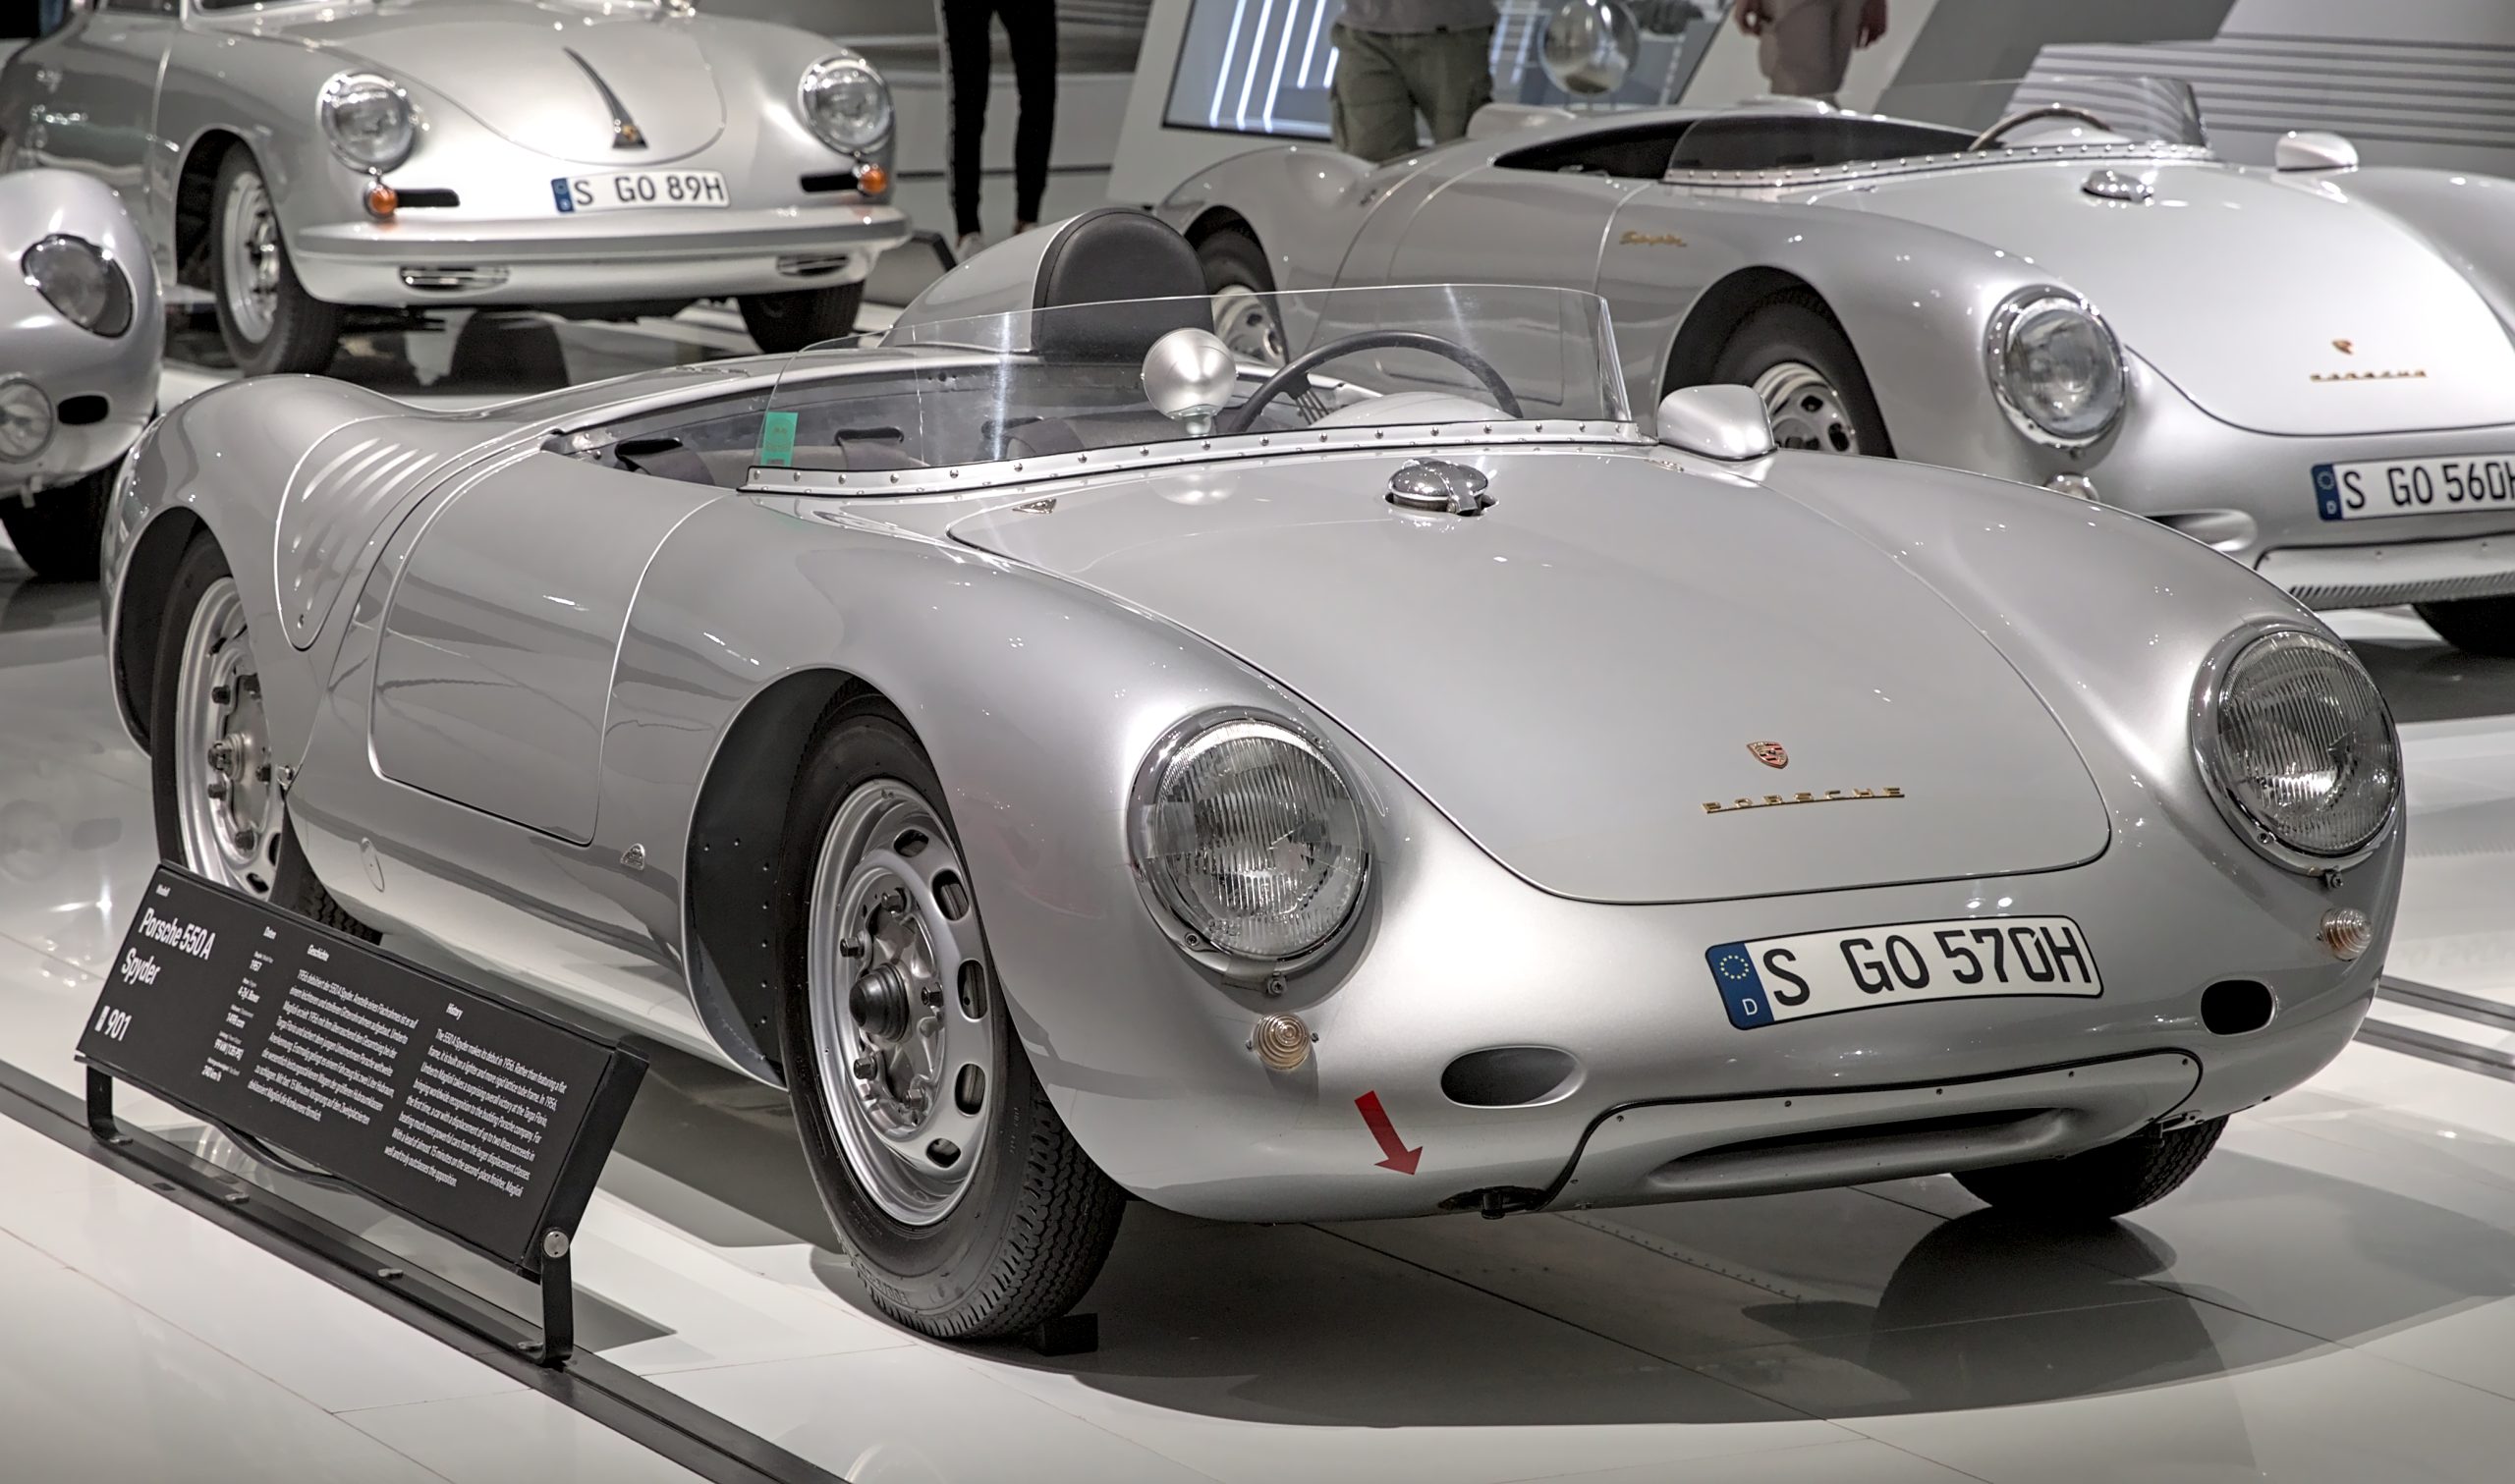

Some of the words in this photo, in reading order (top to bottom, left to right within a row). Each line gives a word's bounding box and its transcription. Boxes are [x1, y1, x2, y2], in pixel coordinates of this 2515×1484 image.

[574, 181, 594, 205] S
[614, 176, 656, 202] GO
[666, 176, 724, 200] 89H
[2342, 471, 2366, 510] S
[2387, 466, 2433, 506] GO
[1702, 787, 1905, 814] PORSCHE
[139, 907, 184, 947] Porsche
[179, 923, 208, 957] 550
[198, 932, 216, 961] A
[121, 947, 161, 985] Spyder
[1762, 948, 1811, 1007] S
[1839, 934, 1930, 995] GO
[1933, 926, 2093, 984] 570H
[104, 1009, 133, 1042] 901
[446, 1003, 463, 1019] History
[1742, 998, 1759, 1016] D
[427, 1045, 441, 1060] frame,
[446, 1054, 458, 1066] built
[464, 1061, 478, 1074] lighter
[494, 1075, 507, 1088] rigid
[503, 1078, 518, 1092] lattice
[544, 1095, 557, 1111] 1956,
[454, 1036, 469, 1051] Spyder
[468, 1045, 481, 1057] makes
[485, 1051, 499, 1064] debut
[502, 1057, 515, 1072] 1956.
[514, 1062, 529, 1076] Rather
[536, 1072, 556, 1091] featuring
[413, 1078, 430, 1096] bringing
[428, 1087, 450, 1102] worldwide
[448, 1096, 472, 1111] recognition
[480, 1109, 499, 1127] budding
[497, 1116, 515, 1131] Porsche
[513, 1126, 533, 1142] company.
[420, 1062, 439, 1077] Umberto
[437, 1070, 455, 1084] Maglioli
[452, 1077, 465, 1089] takes
[466, 1084, 486, 1101] surprising
[484, 1092, 500, 1104] overall
[498, 1099, 513, 1113] victory
[524, 1106, 535, 1123] Targa
[533, 1111, 547, 1127] Florio,
[398, 1111, 415, 1128] beating
[432, 1129, 454, 1143] powerful
[475, 1146, 489, 1162] larger
[487, 1152, 516, 1173] displacement
[413, 1097, 422, 1110] first
[420, 1102, 431, 1115] time,
[451, 1116, 478, 1135] displacement
[499, 1137, 512, 1150] litres
[510, 1144, 531, 1159] succeeds
[399, 1152, 410, 1166] truly
[408, 1158, 429, 1174] outclasses
[434, 1171, 457, 1186] opposition.
[416, 1140, 431, 1154] almost
[435, 1150, 452, 1164] minutes
[463, 1163, 491, 1182] second-place
[489, 1173, 506, 1189] finisher,
[505, 1181, 524, 1196] Maglioli
